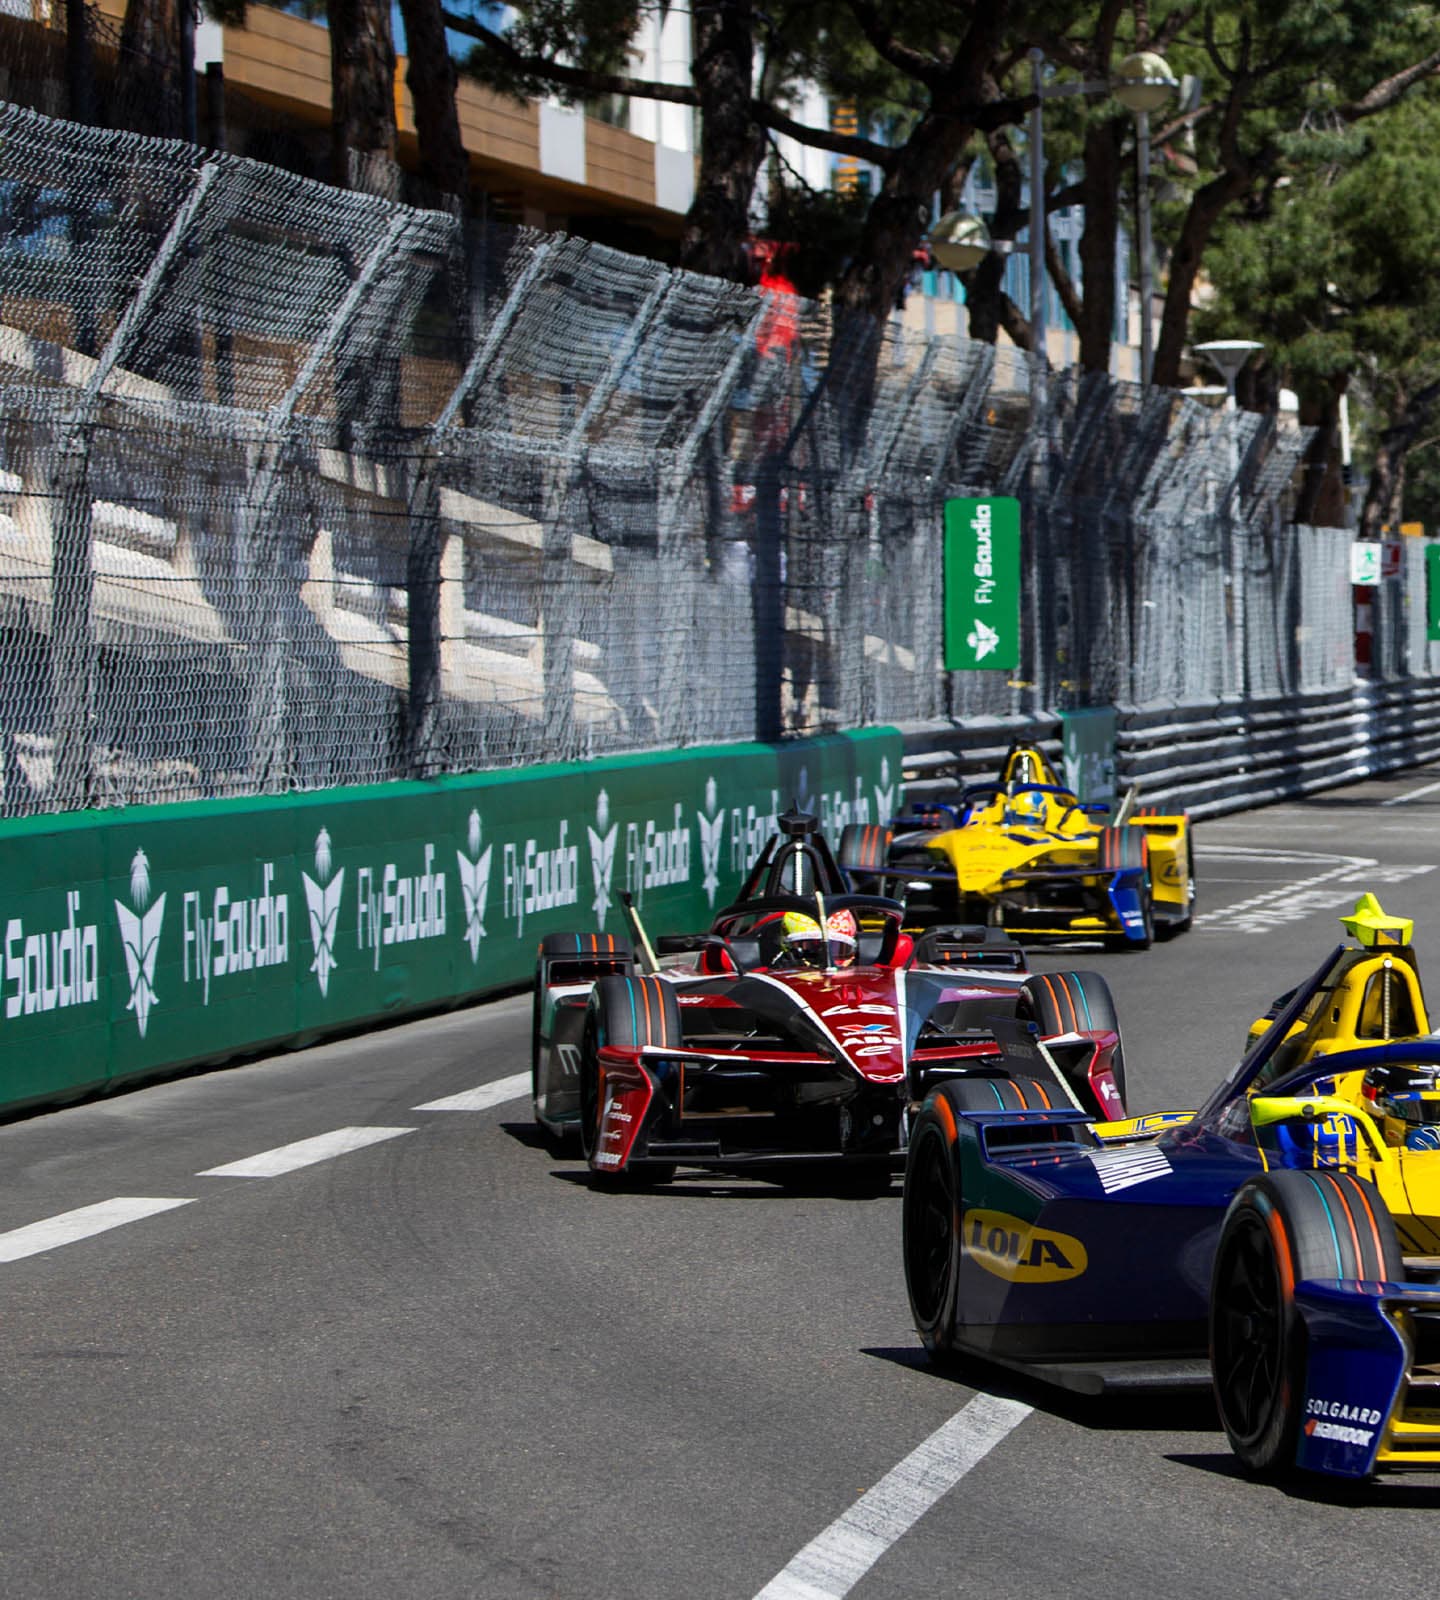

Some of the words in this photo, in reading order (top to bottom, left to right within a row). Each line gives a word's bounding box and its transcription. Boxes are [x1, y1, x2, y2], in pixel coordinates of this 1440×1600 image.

[970, 504, 996, 604] FlySaudia
[357, 843, 446, 972] FlySaudia
[503, 819, 578, 939] FlySaudia
[627, 802, 690, 912] FlySaudia
[0, 890, 98, 1019] Saudia
[183, 862, 288, 1006] FlySaudia
[971, 1218, 1076, 1270] LOLA
[1305, 1398, 1382, 1425] SOLGAARD
